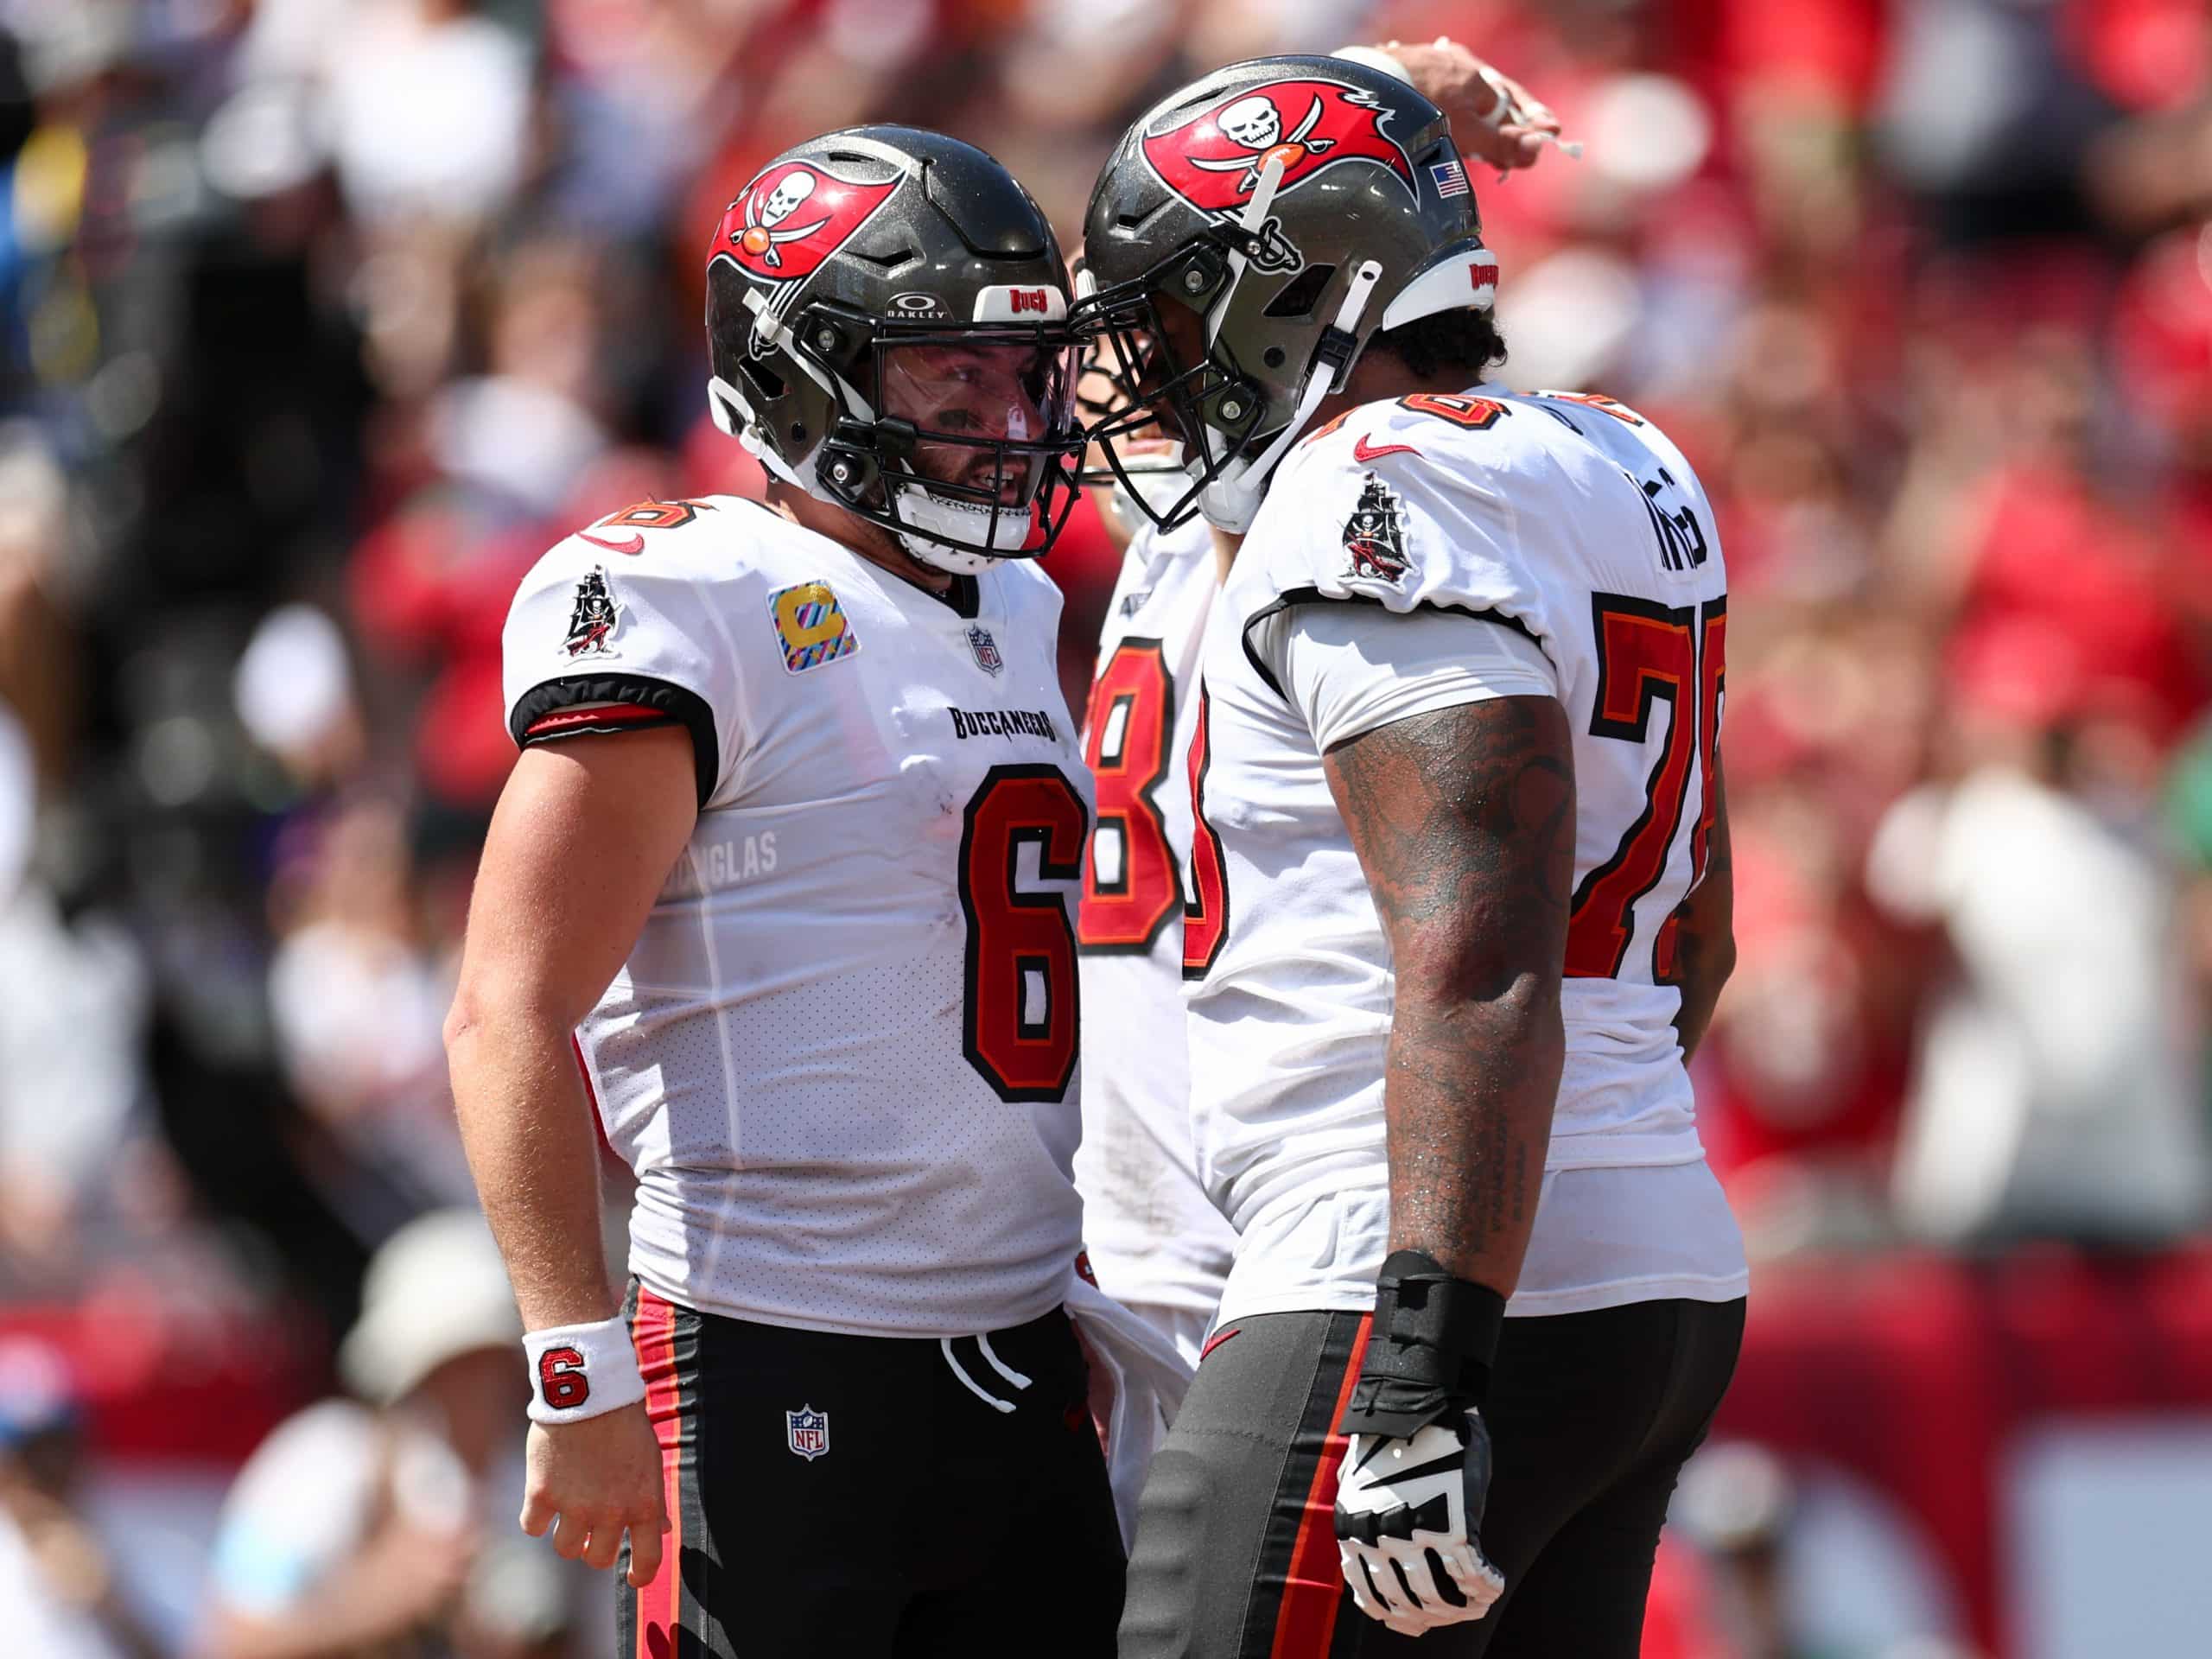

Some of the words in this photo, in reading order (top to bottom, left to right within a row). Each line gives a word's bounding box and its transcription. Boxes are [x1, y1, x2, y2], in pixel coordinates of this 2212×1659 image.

[887, 310, 945, 319] OAKLEY
[978, 647, 1003, 664] NFL
[947, 706, 1056, 742] BUCCANEERS
[958, 763, 1090, 1103] 6
[538, 1347, 589, 1409] 6
[795, 1430, 823, 1450] NFL
